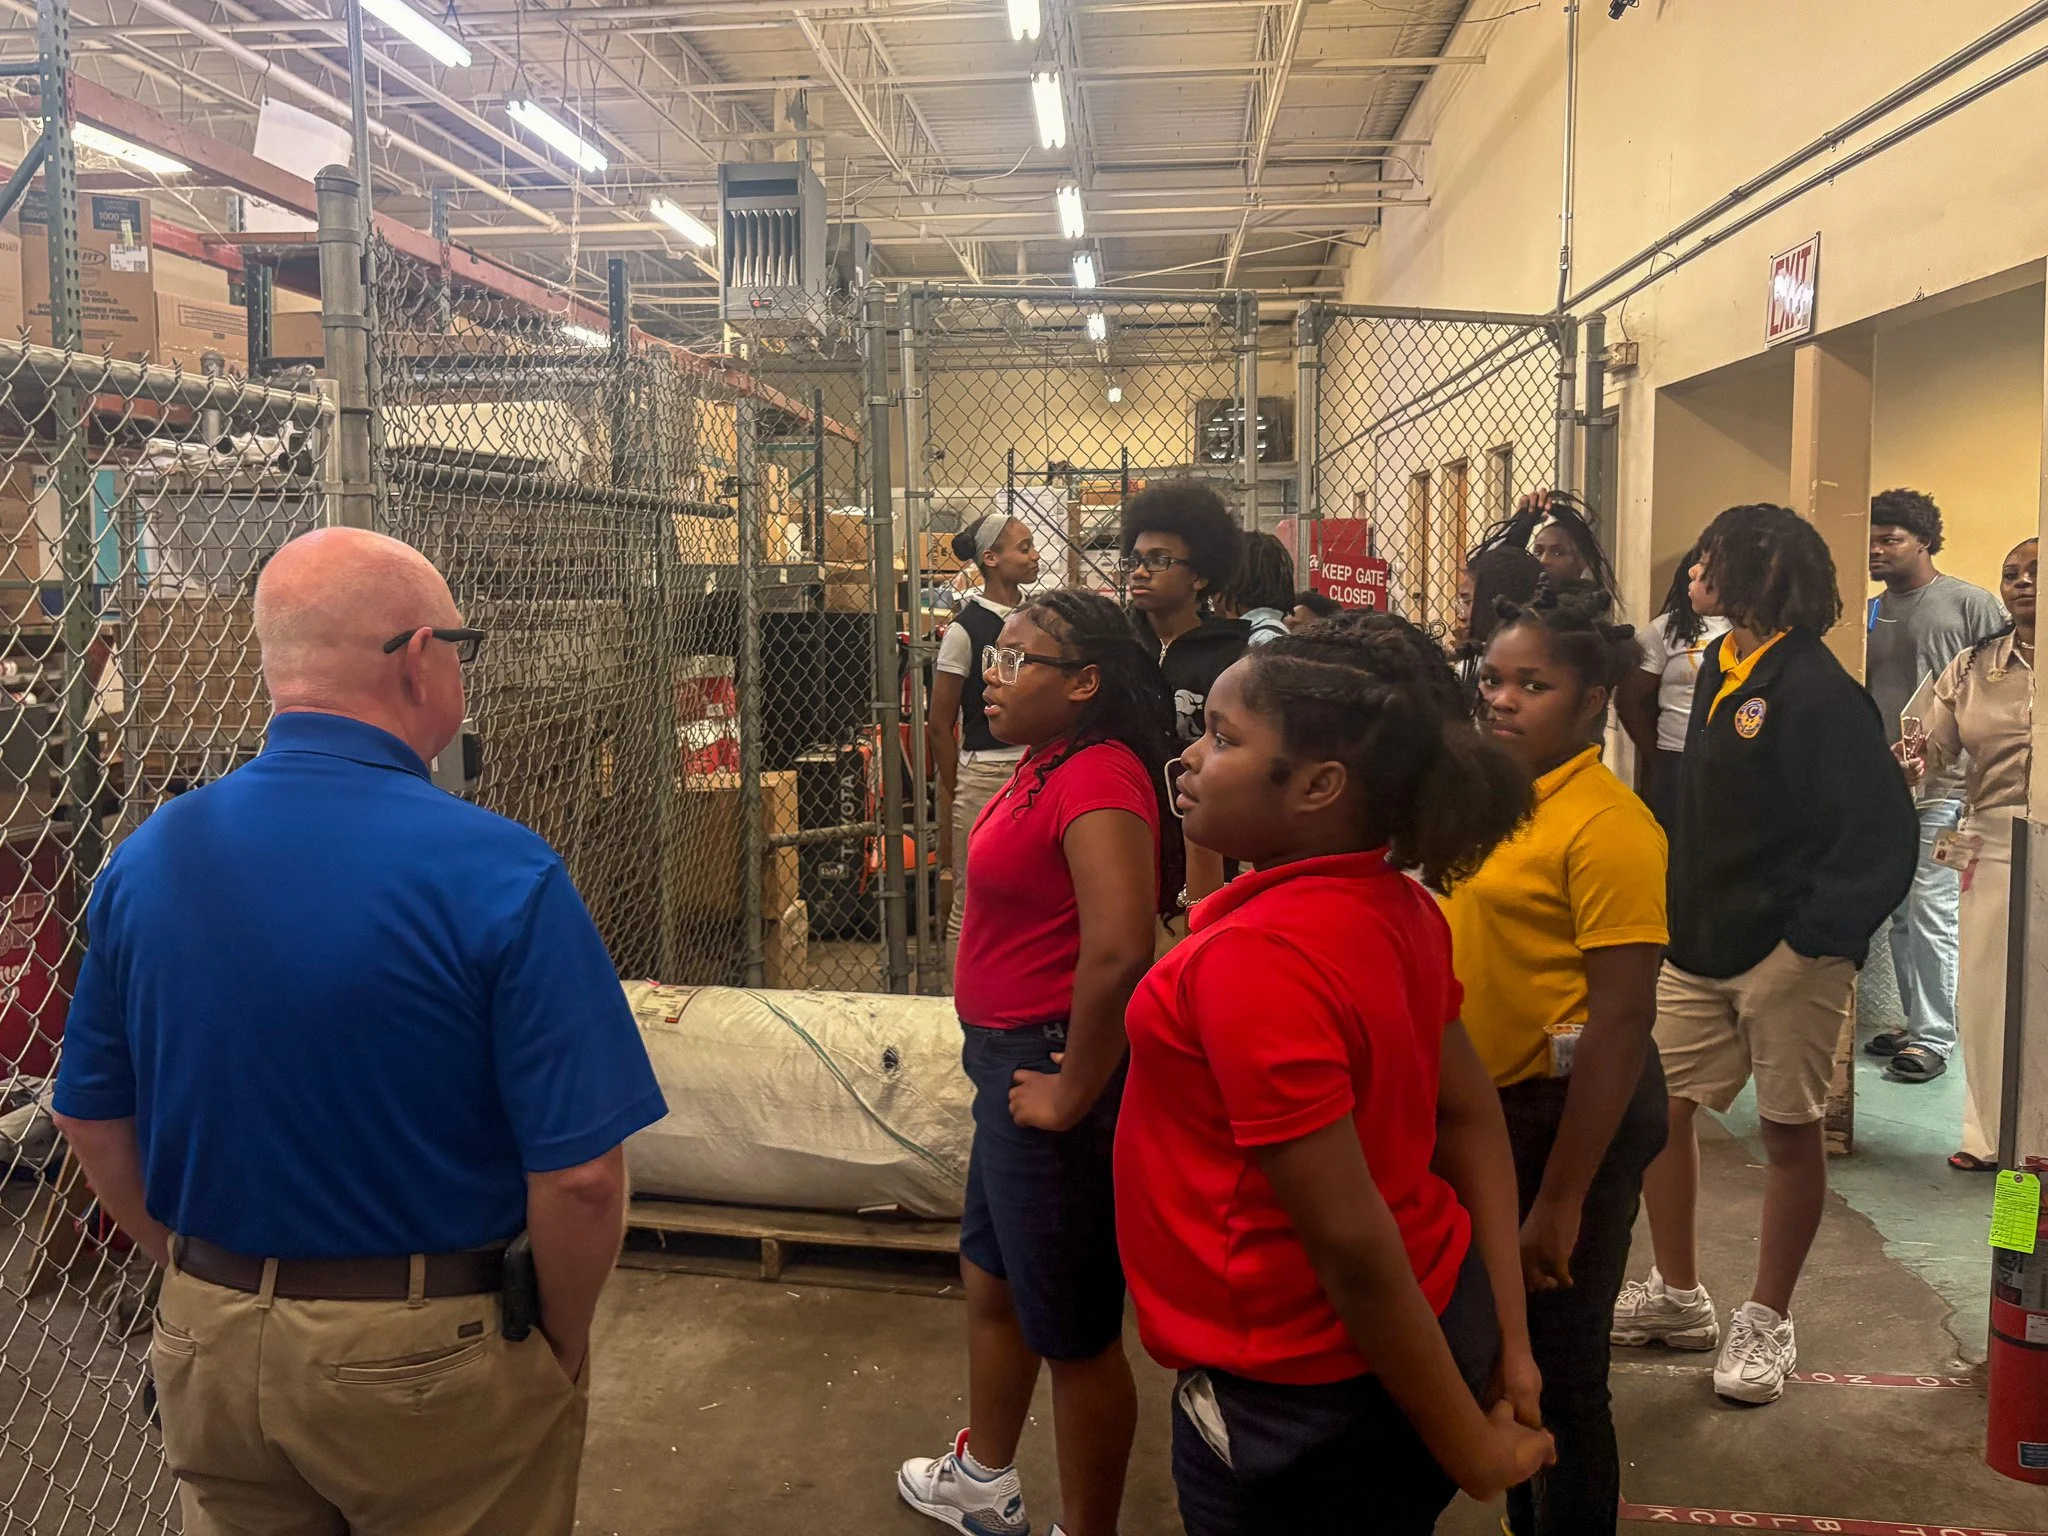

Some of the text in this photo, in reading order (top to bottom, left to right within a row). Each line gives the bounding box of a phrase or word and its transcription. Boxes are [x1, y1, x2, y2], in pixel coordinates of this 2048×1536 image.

[1322, 563, 1384, 587] KEEP GATE
[1329, 585, 1376, 605] CLOSED
[1647, 1508, 1841, 1532] BLOCK
